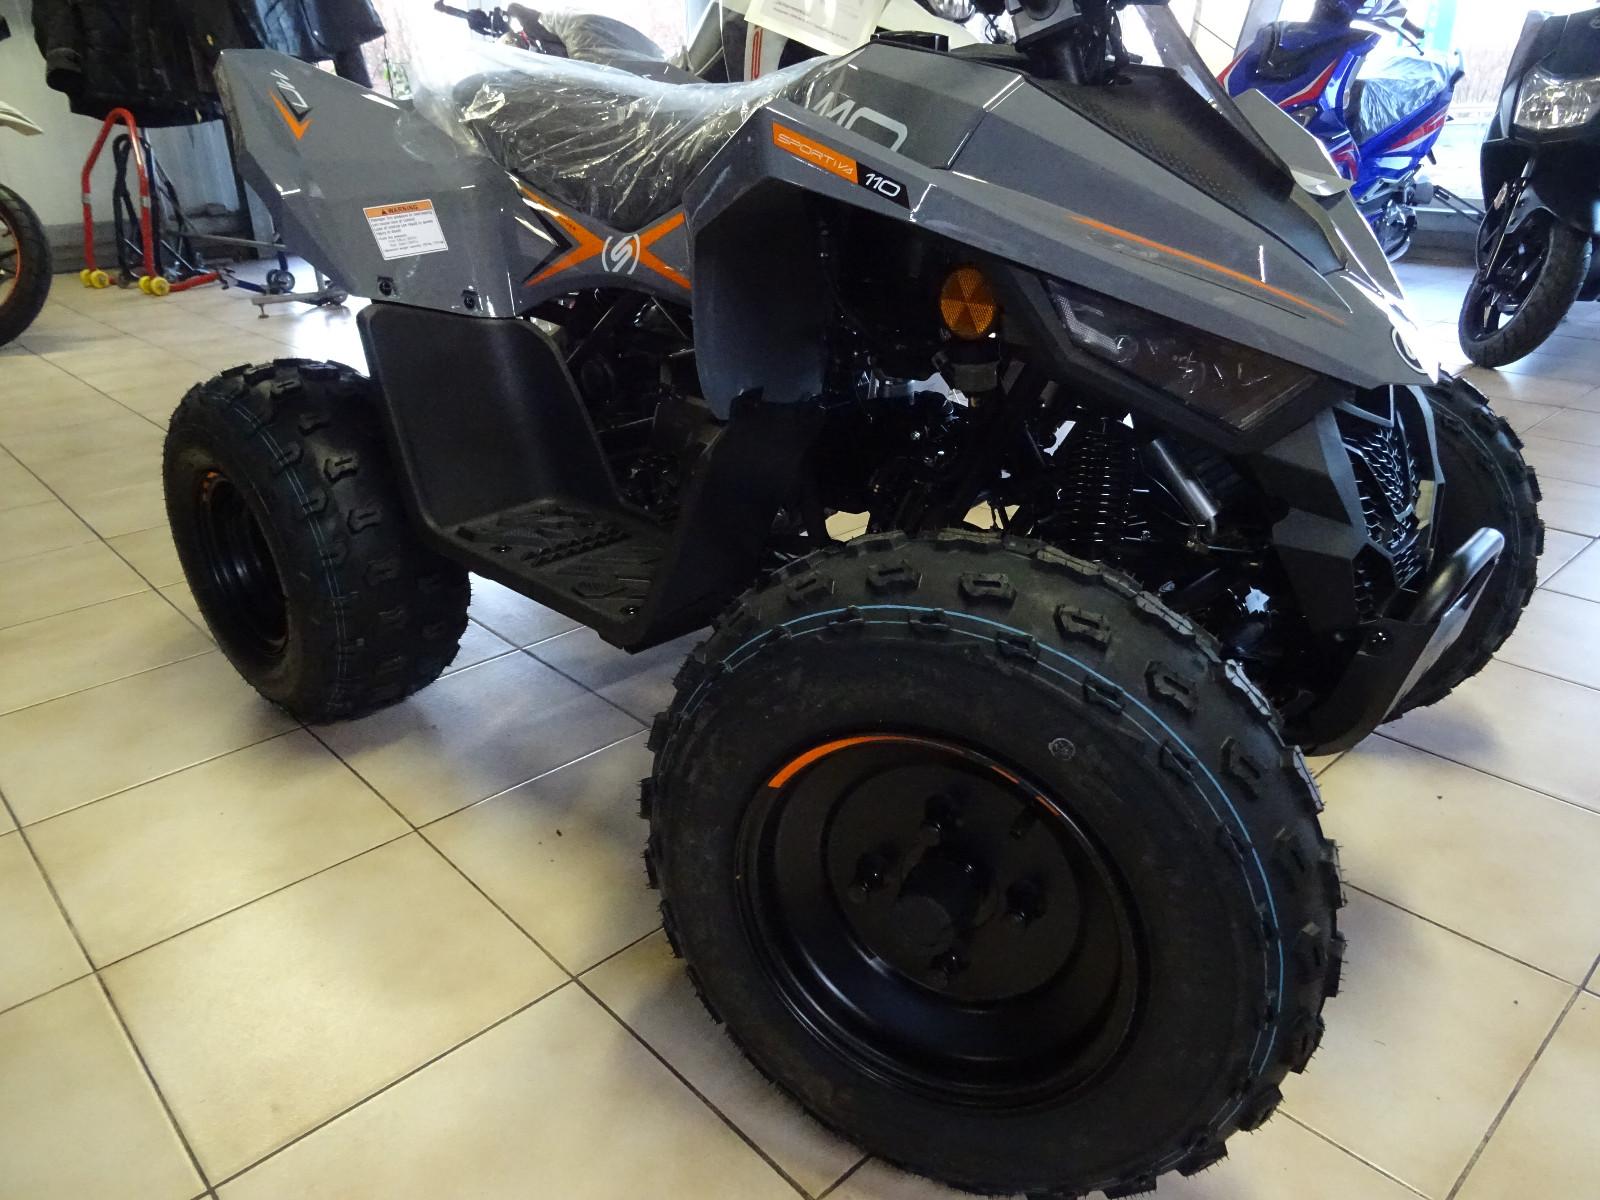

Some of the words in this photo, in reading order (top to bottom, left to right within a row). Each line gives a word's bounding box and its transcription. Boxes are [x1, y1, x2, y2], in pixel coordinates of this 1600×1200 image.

[777, 132, 854, 176] SPORTIVA
[865, 173, 901, 198] 110
[388, 204, 418, 214] WARNING
